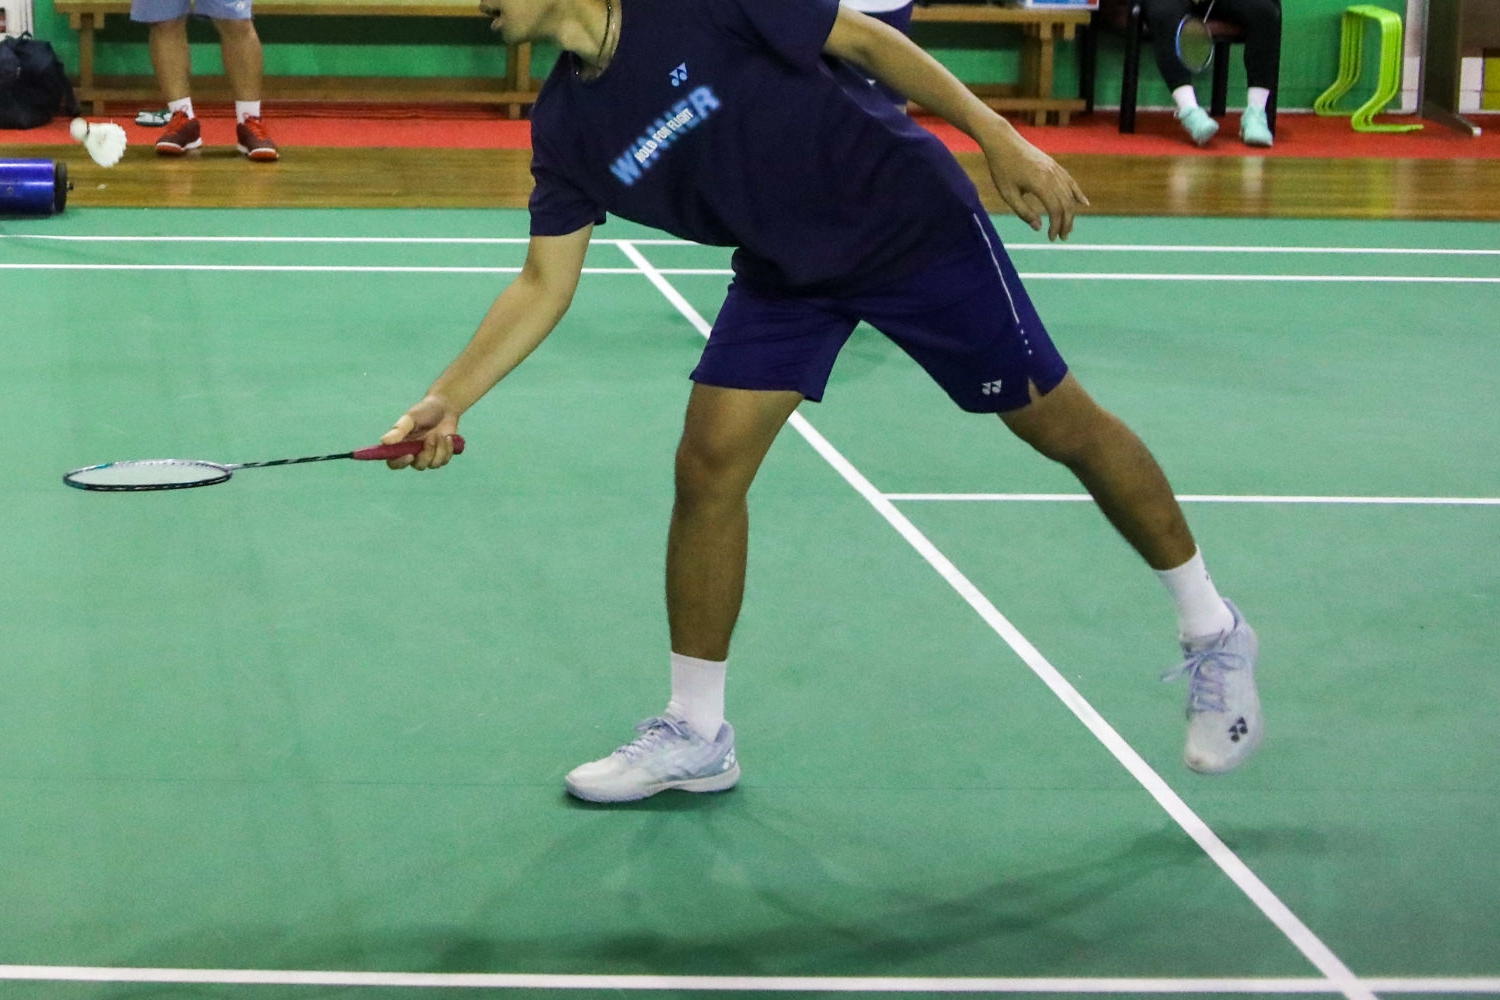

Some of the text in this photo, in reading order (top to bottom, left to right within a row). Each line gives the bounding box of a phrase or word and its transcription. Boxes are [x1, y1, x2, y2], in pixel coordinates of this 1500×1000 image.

[634, 107, 694, 164] HOLD FOR FLIGHT
